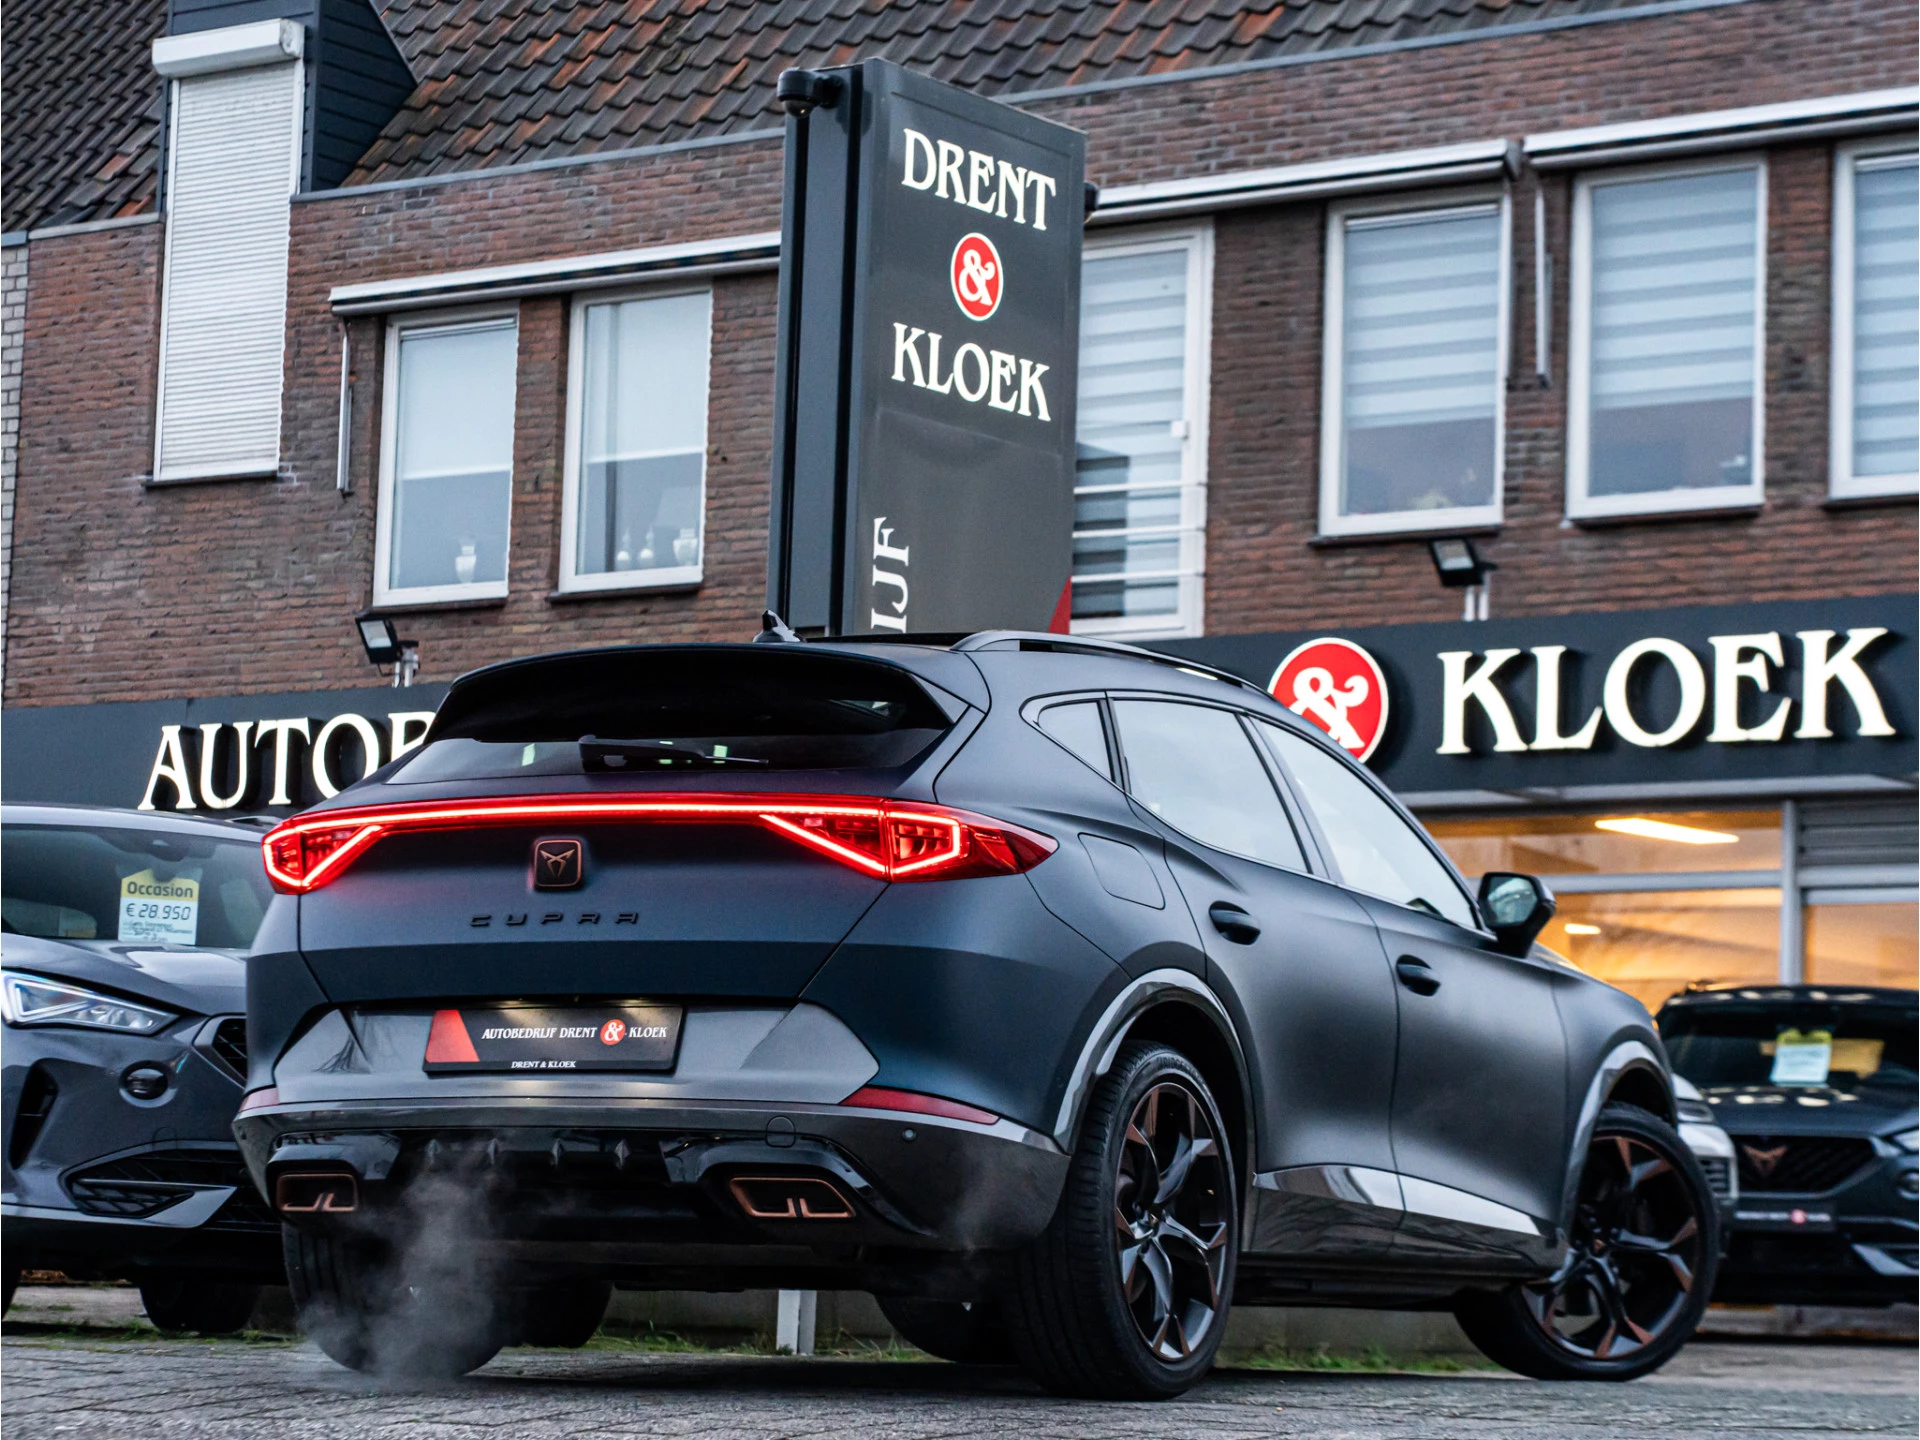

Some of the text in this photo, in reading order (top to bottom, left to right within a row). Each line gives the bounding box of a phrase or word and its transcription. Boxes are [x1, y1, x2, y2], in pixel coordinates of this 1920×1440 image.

[901, 127, 1057, 231] DRENT
[958, 249, 996, 306] &
[891, 321, 1052, 422] KLOEK
[1288, 666, 1366, 749] &
[1436, 627, 1897, 755] KLOEK
[127, 881, 194, 898] Occasion
[138, 904, 191, 920] 28.950
[470, 911, 640, 927] CUPRA
[481, 1021, 667, 1042] AUTOBEDRIJF DRENT & KLOEK
[511, 1060, 540, 1069] DRENT
[548, 1060, 576, 1068] KLOEK
